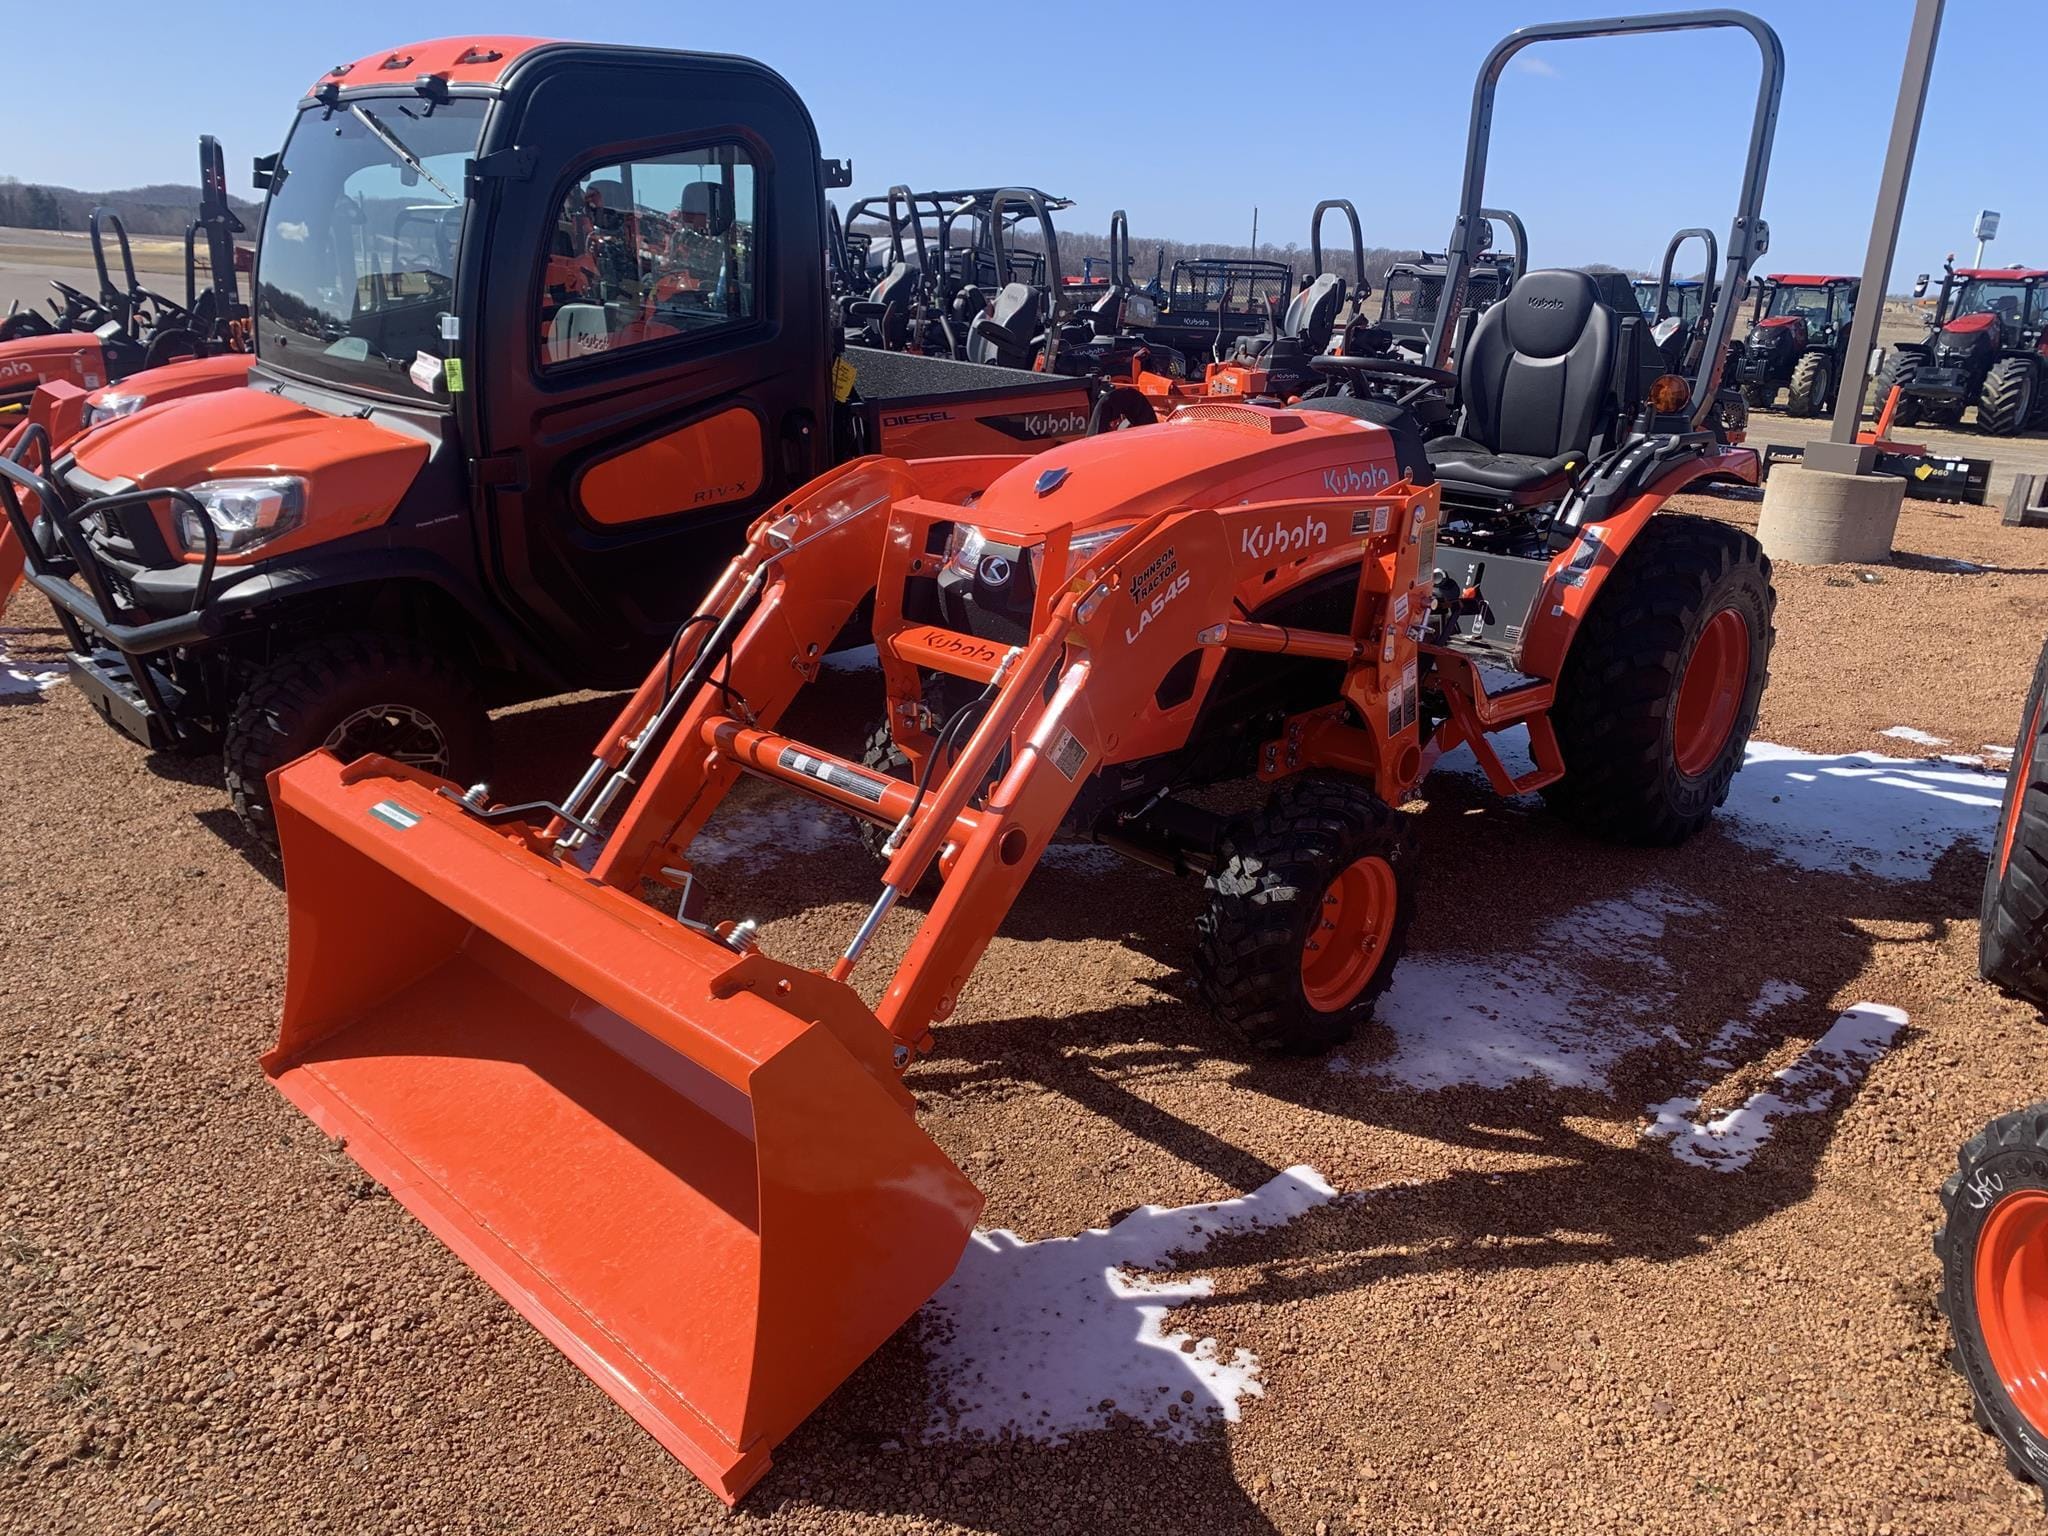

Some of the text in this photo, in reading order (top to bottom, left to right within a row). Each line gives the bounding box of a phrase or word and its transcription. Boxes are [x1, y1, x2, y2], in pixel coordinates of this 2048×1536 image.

[1529, 296, 1565, 310] Kubota
[1184, 318, 1210, 327] Kubota
[882, 411, 955, 427] DIESEL
[1025, 401, 1086, 436] Kubota
[694, 480, 746, 503] RTV-X
[1323, 463, 1390, 495] Kubota
[1241, 515, 1327, 559] Kubota
[1129, 546, 1175, 594] JOHNSON
[1132, 560, 1178, 605] TRACTOR
[1125, 569, 1191, 645] LA545
[922, 631, 996, 662] Kubota
